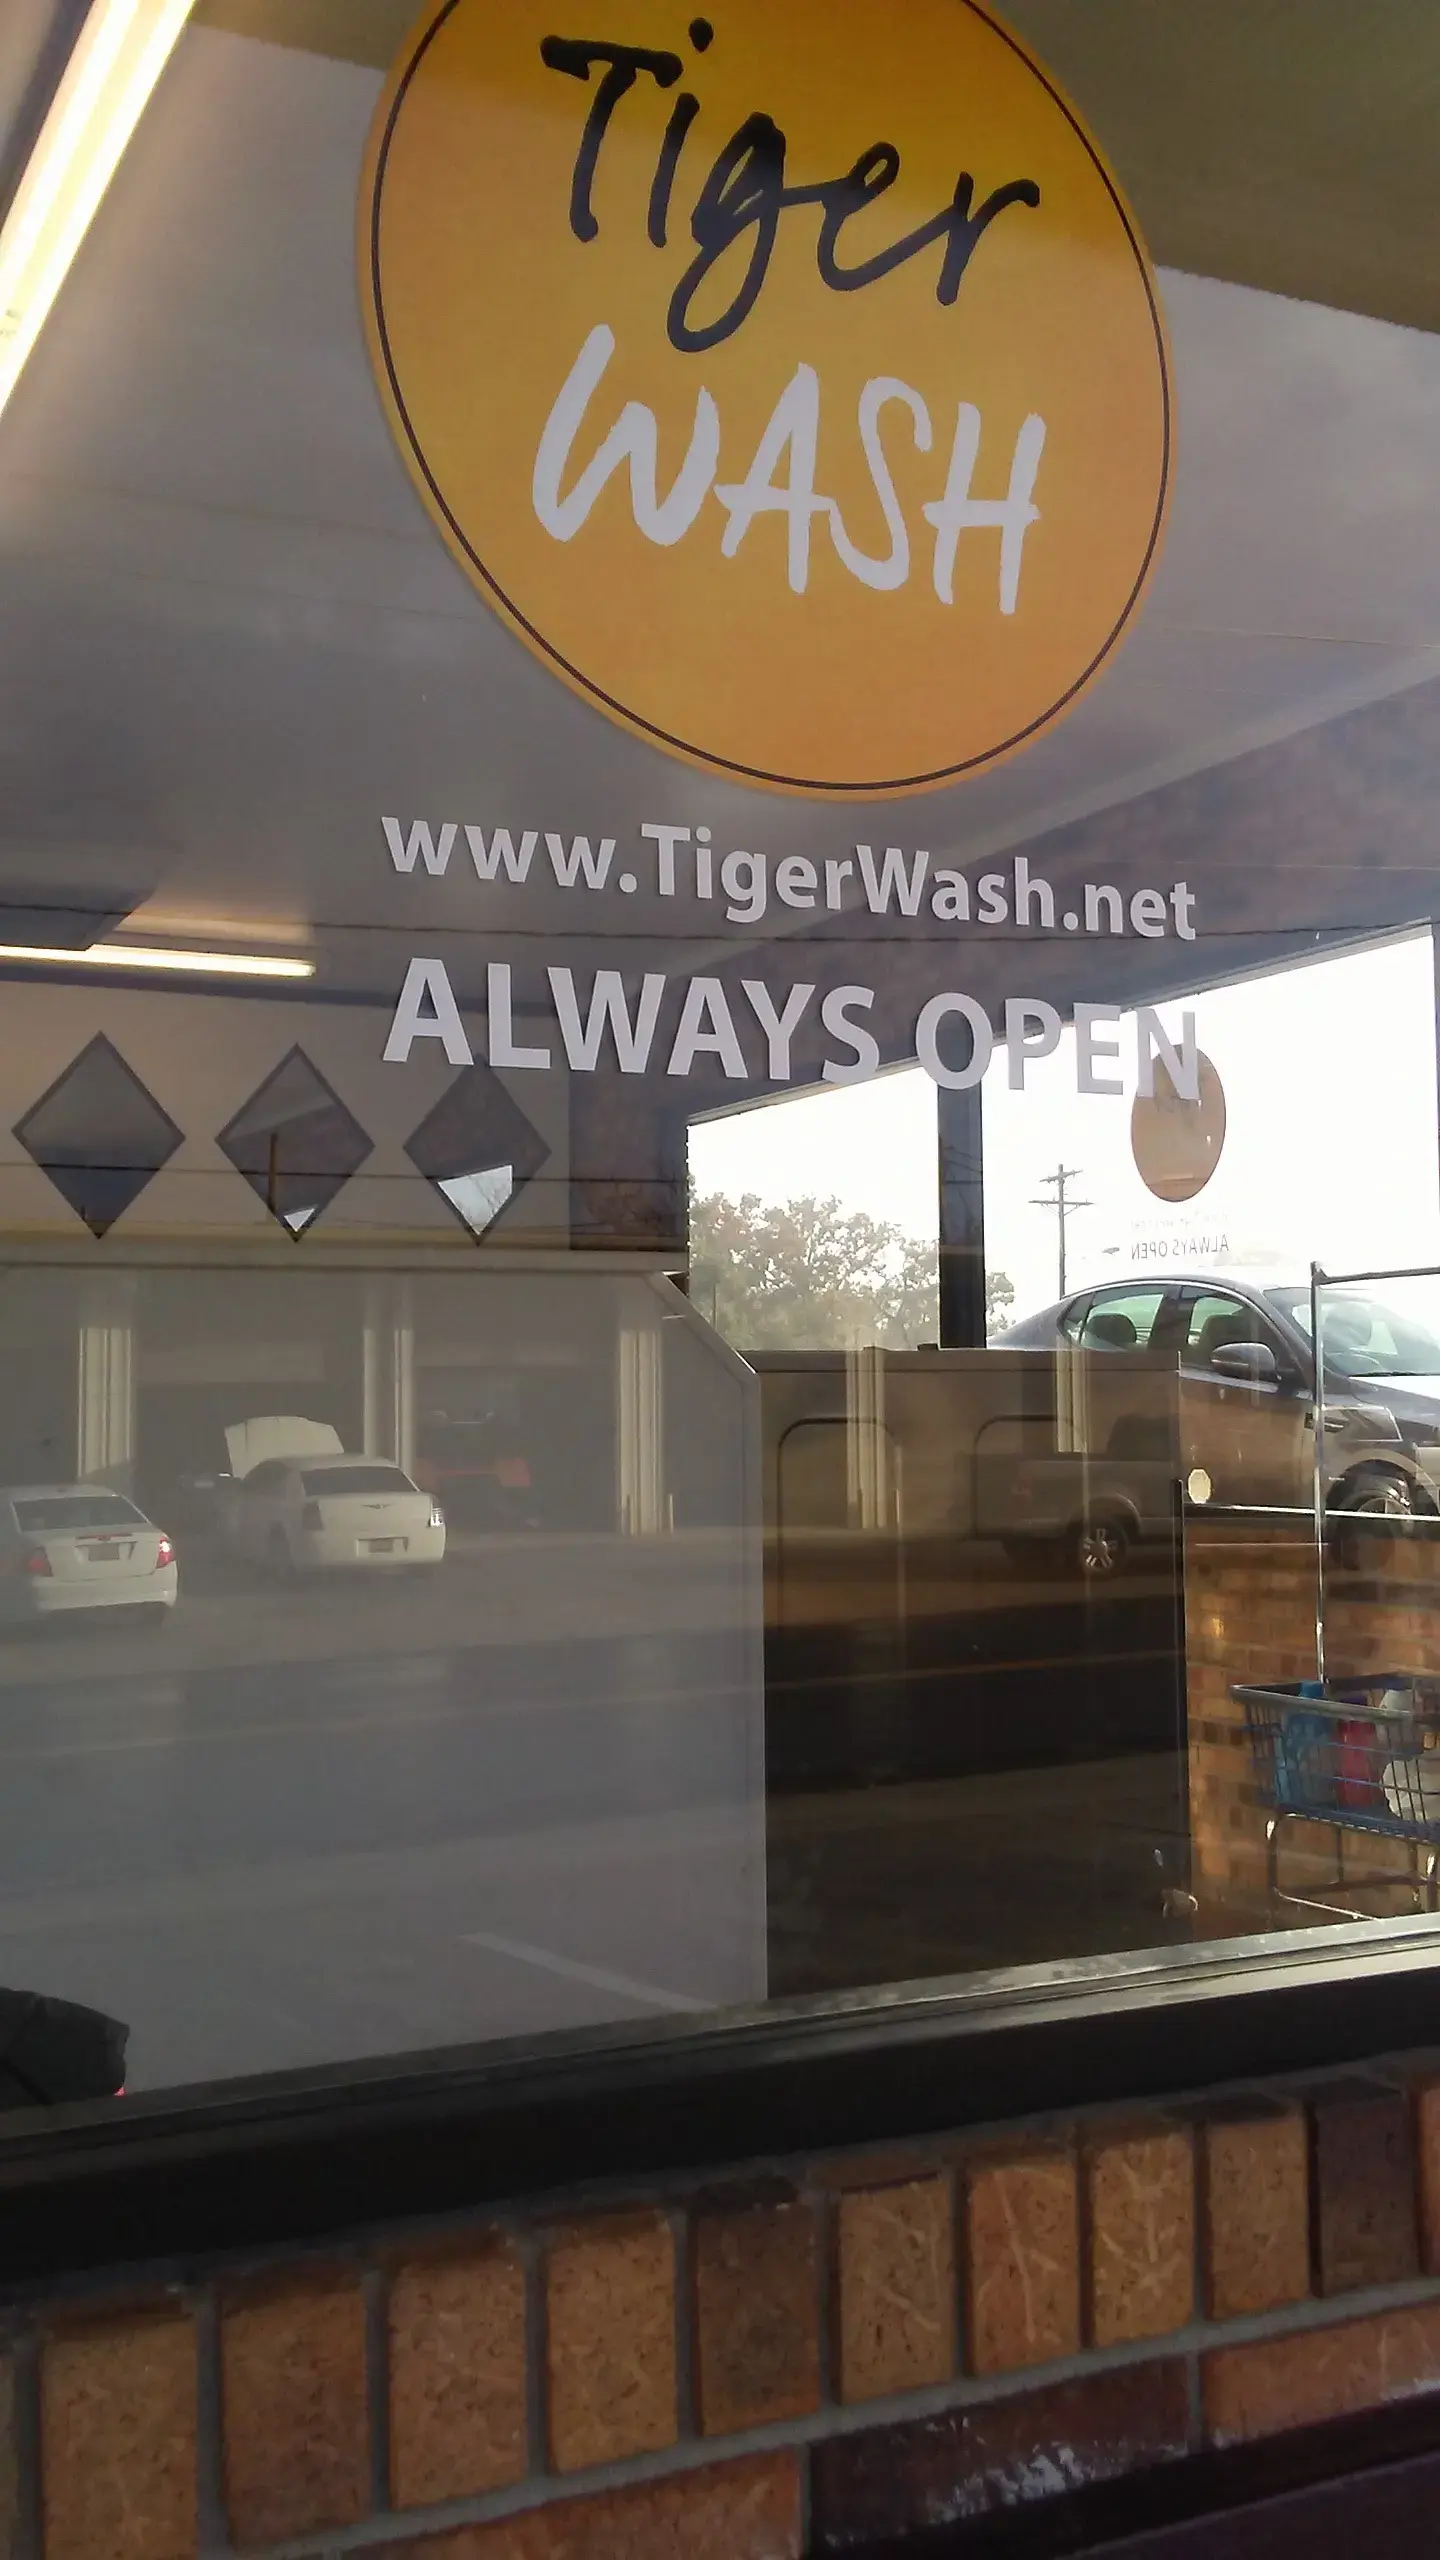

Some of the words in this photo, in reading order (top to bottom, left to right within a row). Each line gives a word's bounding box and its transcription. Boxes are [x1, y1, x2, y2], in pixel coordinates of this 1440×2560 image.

[541, 18, 1041, 353] Tiger
[533, 324, 1047, 615] WASH
[382, 816, 1198, 940] www.TigerWash.net
[383, 958, 880, 1084] ALWAYS
[915, 993, 1201, 1101] OPEN
